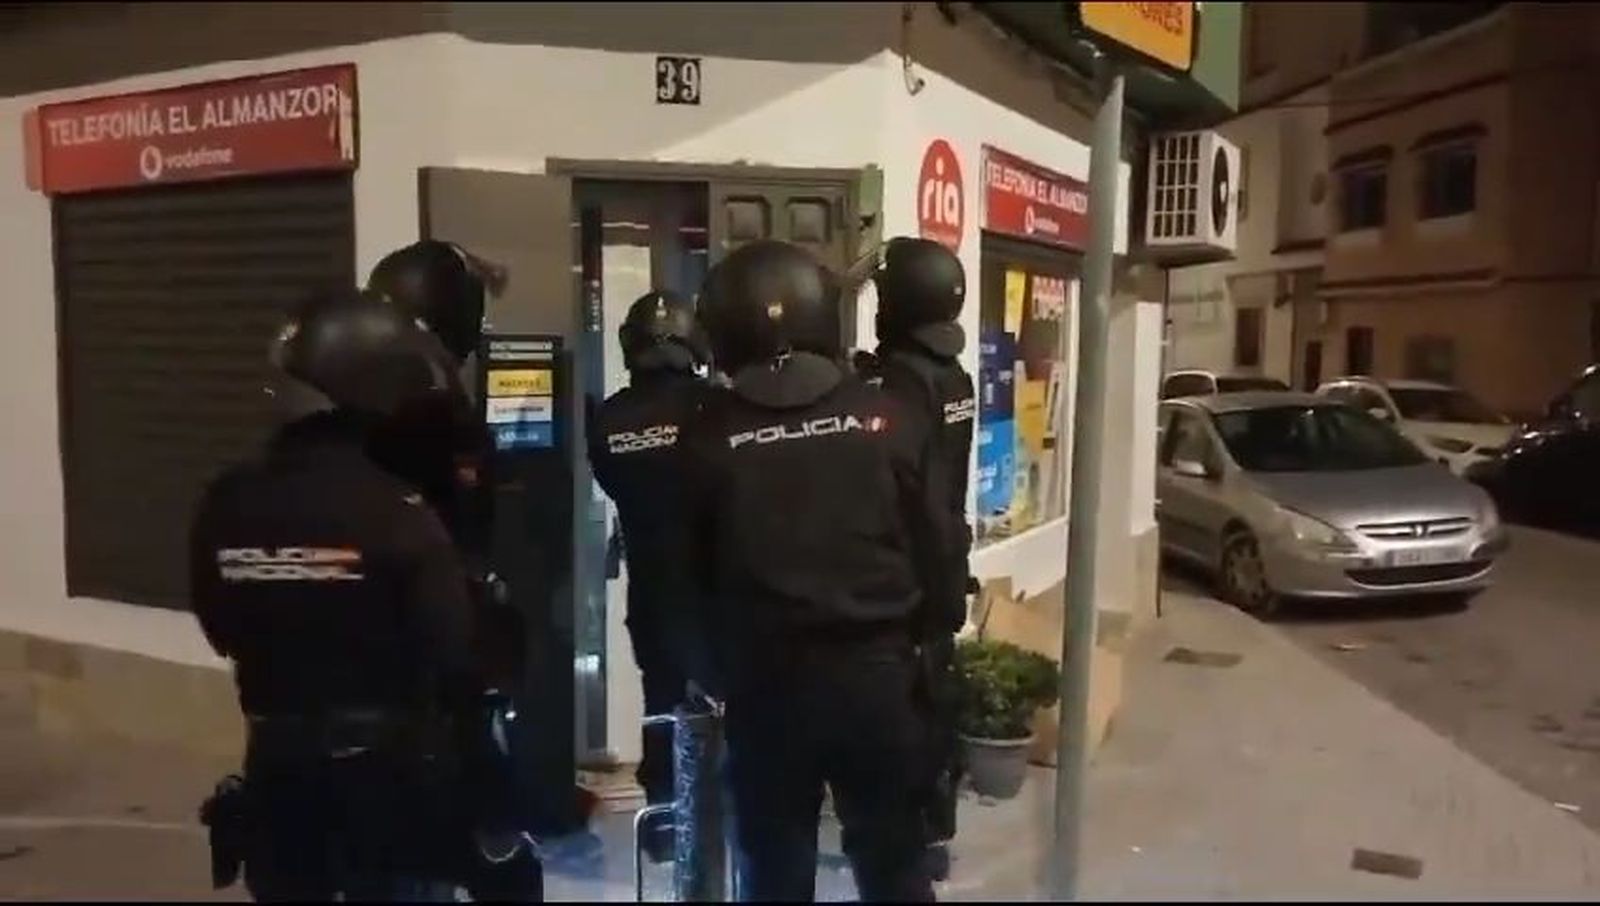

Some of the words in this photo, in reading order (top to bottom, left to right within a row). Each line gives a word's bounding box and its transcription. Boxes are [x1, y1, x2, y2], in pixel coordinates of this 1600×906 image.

[659, 60, 698, 101] 39
[168, 105, 198, 134] EL
[201, 83, 338, 129] ALMANZOR
[922, 156, 960, 227] ria
[729, 415, 862, 448] POLICIA
